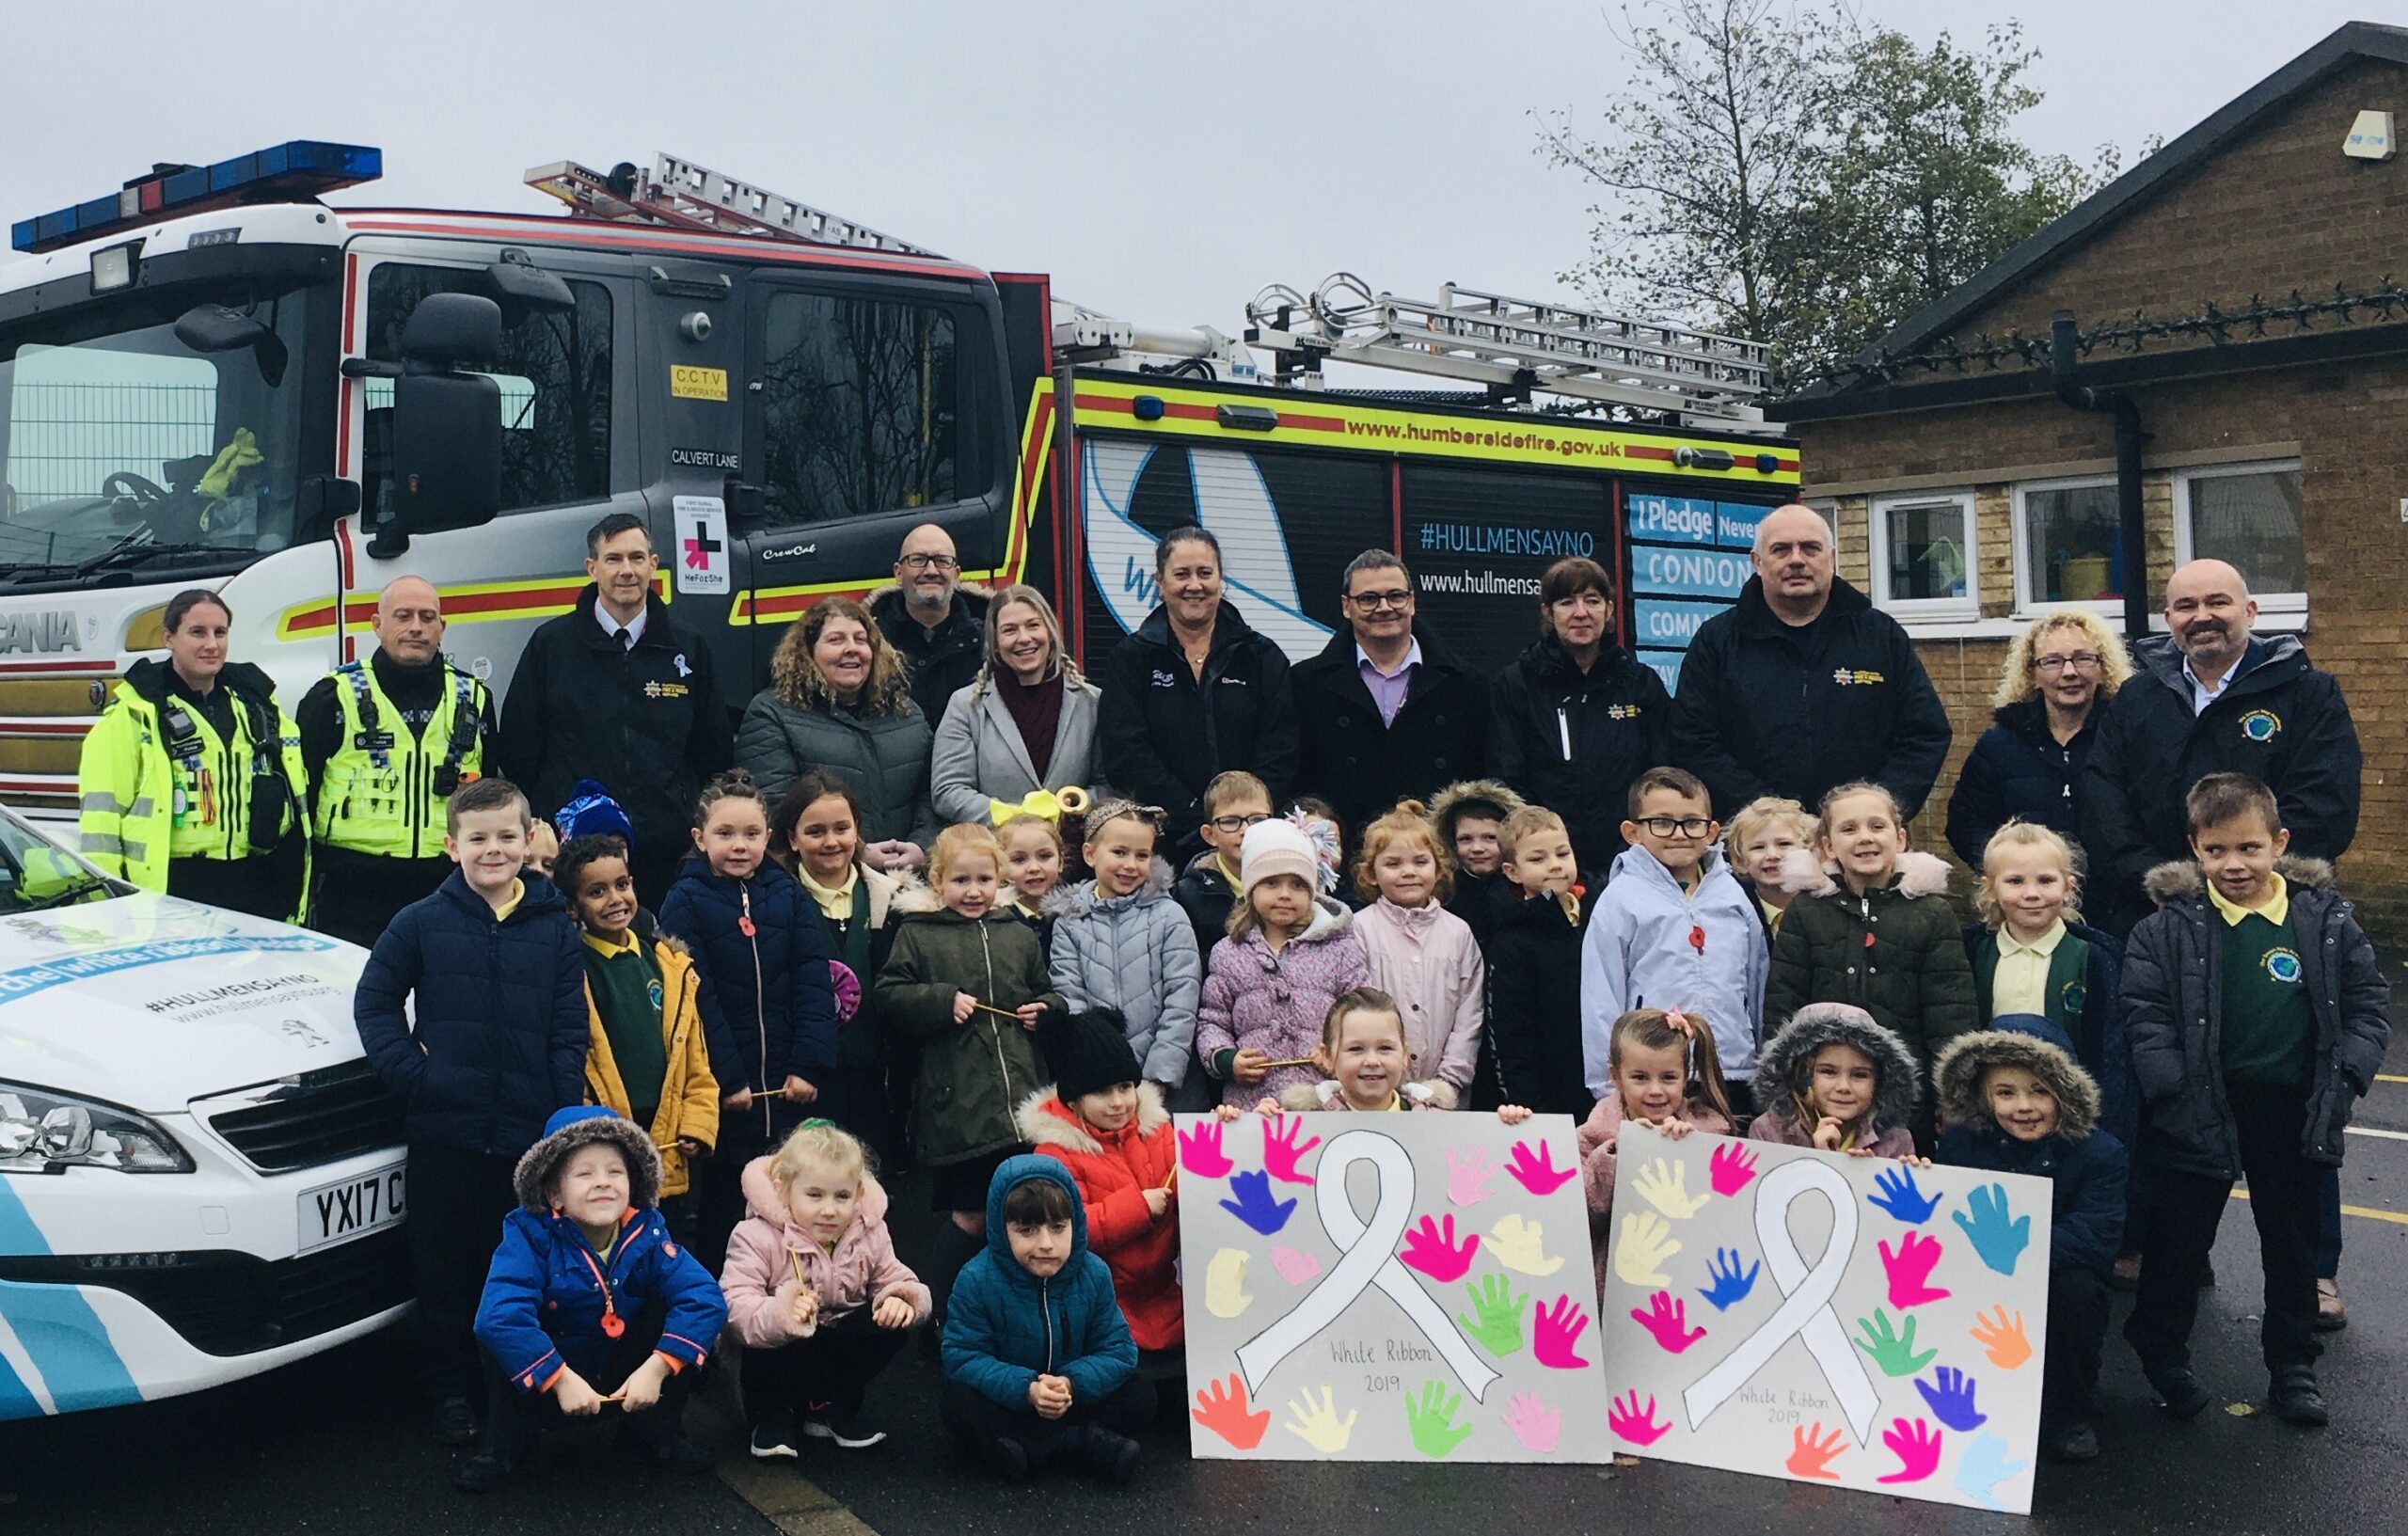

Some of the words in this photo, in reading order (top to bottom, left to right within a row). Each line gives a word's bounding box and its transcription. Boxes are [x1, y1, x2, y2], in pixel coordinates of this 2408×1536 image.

[682, 387, 726, 398] OPERATION
[1347, 421, 1621, 457] www.humbersidefire.gov.uk
[672, 450, 714, 466] CALVERT
[716, 453, 737, 468] LANE
[1648, 499, 1712, 541] Pledge
[763, 544, 816, 560] CrewCab
[1420, 523, 1593, 558] #HULLMENSAYNO
[685, 573, 722, 583] HeForShe
[1419, 569, 1542, 595] www.hullmensa
[1648, 553, 1752, 589] CONDON
[146, 974, 320, 1013] #HULLMENSAYNO
[316, 1177, 380, 1238] YX17
[1330, 1339, 1376, 1364] White
[1386, 1338, 1433, 1362] Ribbon
[1365, 1374, 1401, 1392] 2019
[1740, 1385, 1777, 1404] White
[1789, 1389, 1830, 1409] Ribbon
[1767, 1409, 1800, 1424] 2019
